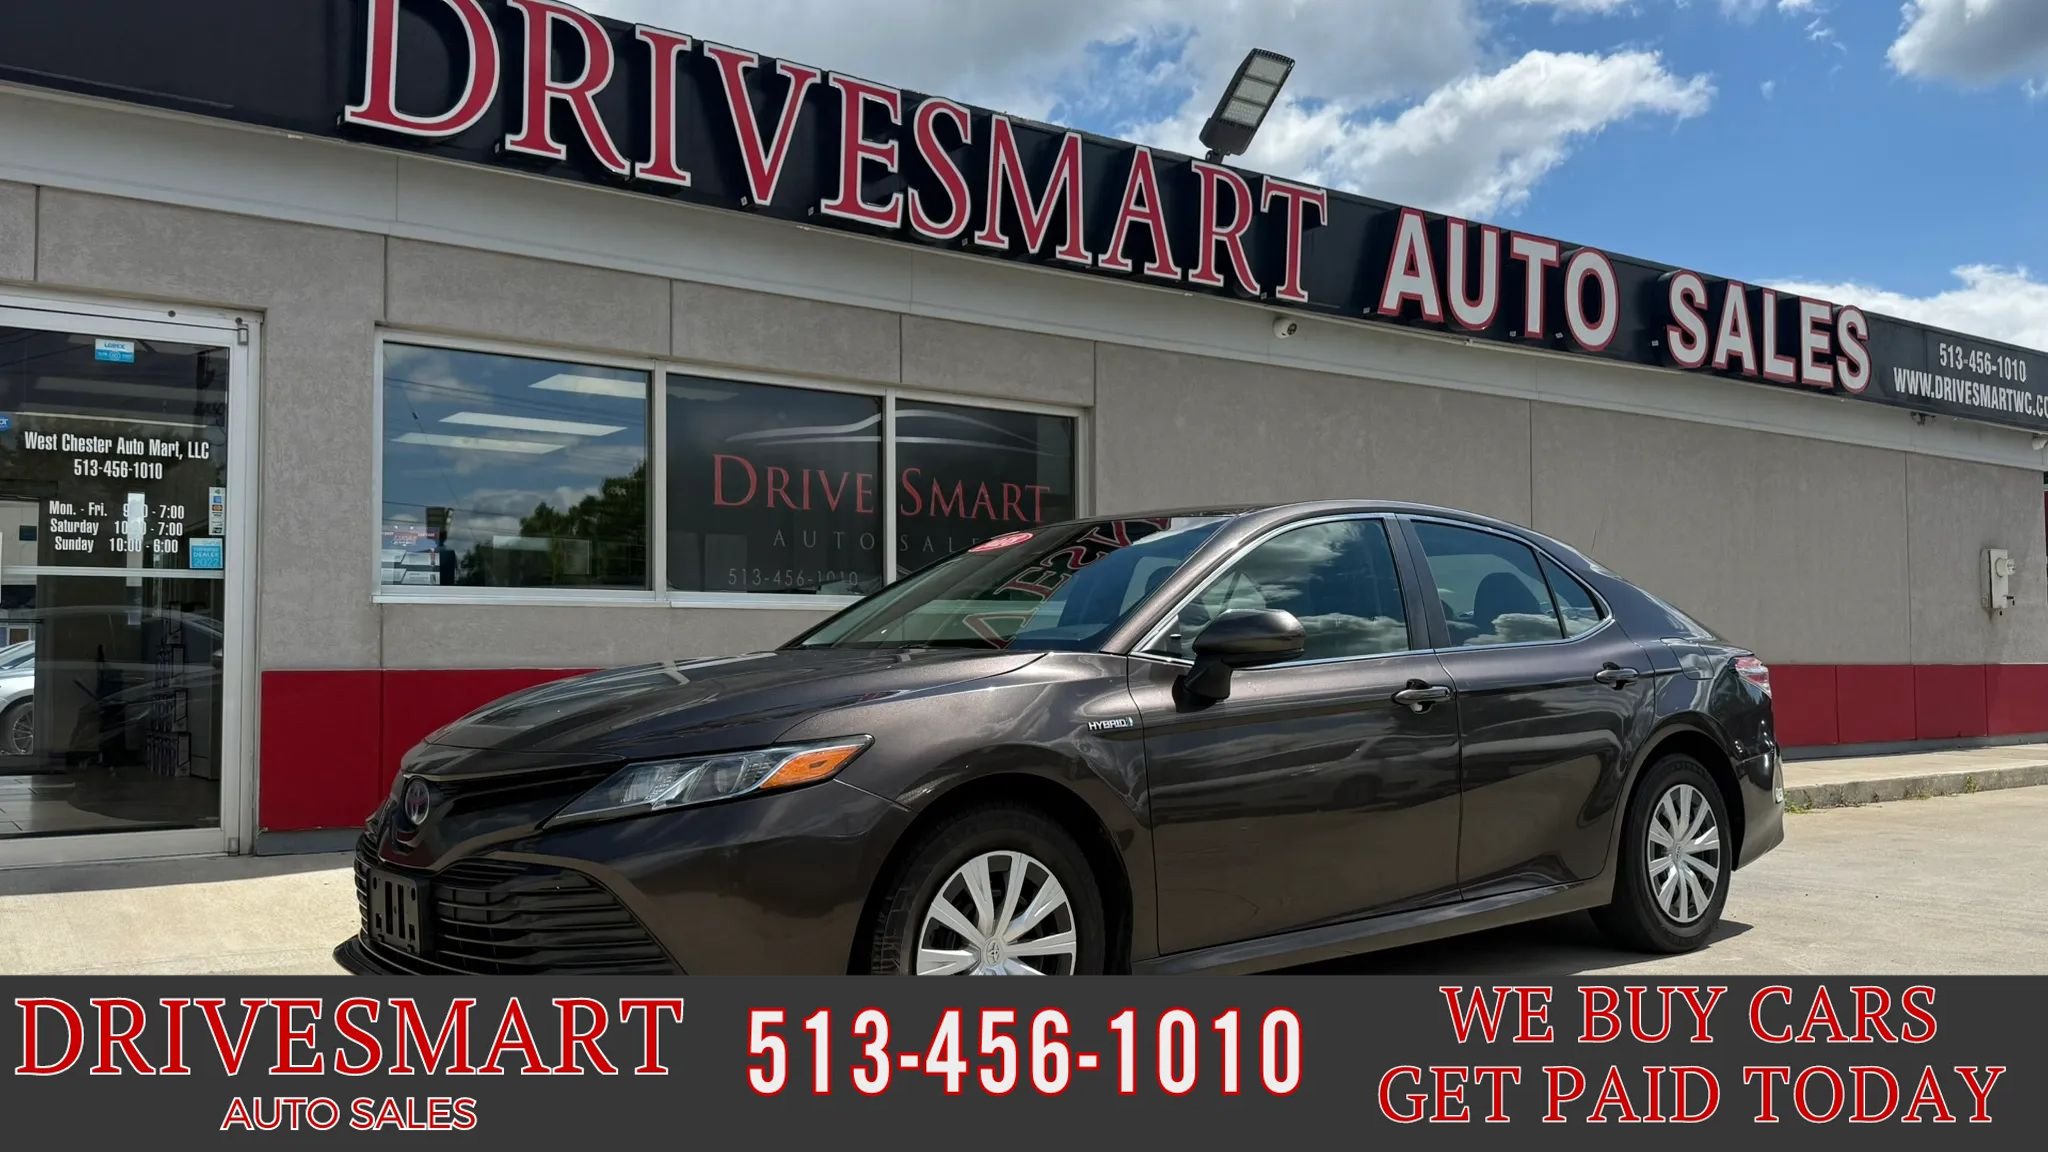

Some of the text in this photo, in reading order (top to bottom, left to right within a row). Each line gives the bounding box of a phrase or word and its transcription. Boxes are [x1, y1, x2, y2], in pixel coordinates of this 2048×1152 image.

[345, 0, 1872, 393] DRIVESMART AUTO SALES
[1939, 343, 2027, 383] 513-456-1010
[25, 431, 209, 460] West Chester Auto Mart, LLC
[74, 459, 163, 480] 513-456-1010
[712, 454, 1050, 522] DRIVE SMART
[49, 500, 77, 516] Mon.
[88, 502, 108, 517] Fri.
[123, 503, 148, 518] 90
[159, 505, 185, 519] 7:00
[50, 518, 99, 536] Saturday
[114, 520, 147, 535] 100
[158, 522, 183, 536] 7:00
[55, 536, 94, 553] Sunday
[109, 538, 142, 552] 10:00
[153, 539, 179, 553] 6:00
[773, 529, 875, 550] AUTO
[900, 534, 980, 553] SAL
[1088, 719, 1126, 730] HYBRID
